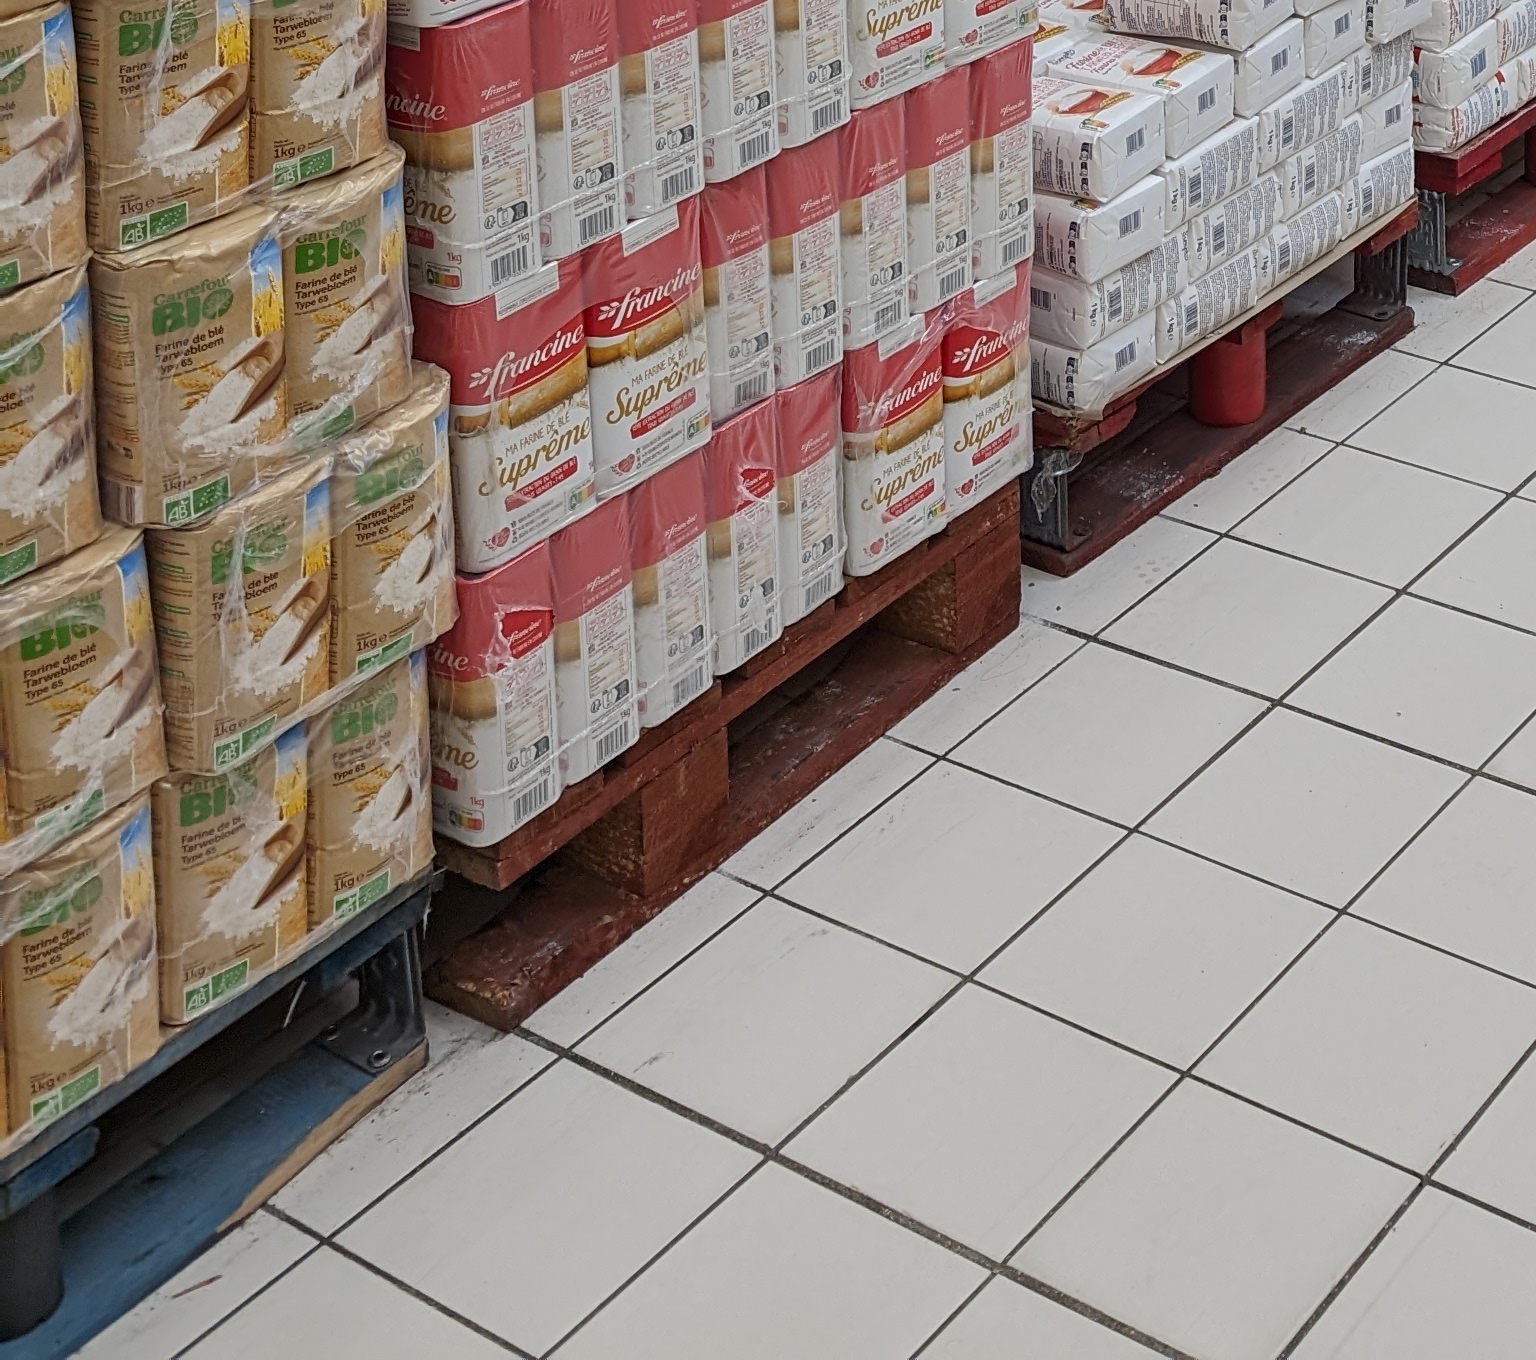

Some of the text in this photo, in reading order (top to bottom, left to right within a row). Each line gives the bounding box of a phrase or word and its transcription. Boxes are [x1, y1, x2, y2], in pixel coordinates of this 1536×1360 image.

[611, 262, 701, 330] francine
[483, 324, 583, 398] francine
[606, 350, 706, 424] Suprême
